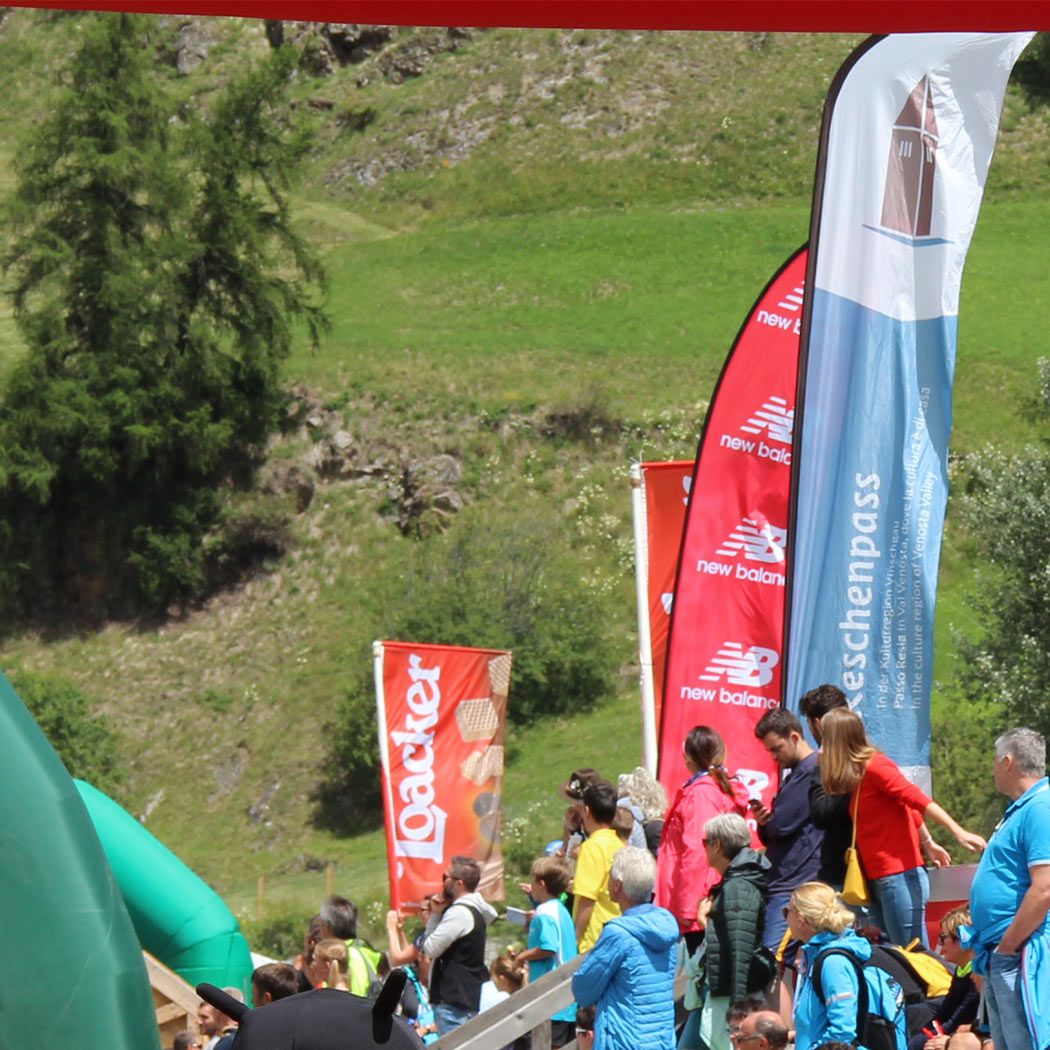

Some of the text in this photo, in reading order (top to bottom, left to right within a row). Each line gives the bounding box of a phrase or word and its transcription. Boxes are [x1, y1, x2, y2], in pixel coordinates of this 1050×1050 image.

[757, 310, 792, 330] new
[917, 387, 931, 415] casa
[720, 434, 756, 453] new
[904, 443, 921, 487] cultura
[902, 489, 914, 501] la
[918, 471, 938, 507] Valley
[900, 503, 911, 535] dove
[911, 510, 930, 560] Venosta
[885, 520, 899, 586] Vinschgau
[911, 562, 921, 577] of
[697, 560, 786, 586] new balan
[897, 597, 906, 616] Val
[911, 580, 924, 622] region
[879, 590, 894, 669] Kulturregion
[895, 635, 907, 669] Resia
[912, 624, 923, 670] culture
[680, 686, 716, 701] new
[893, 672, 906, 709] Passo
[911, 672, 923, 693] the
[391, 653, 448, 864] Loacker
